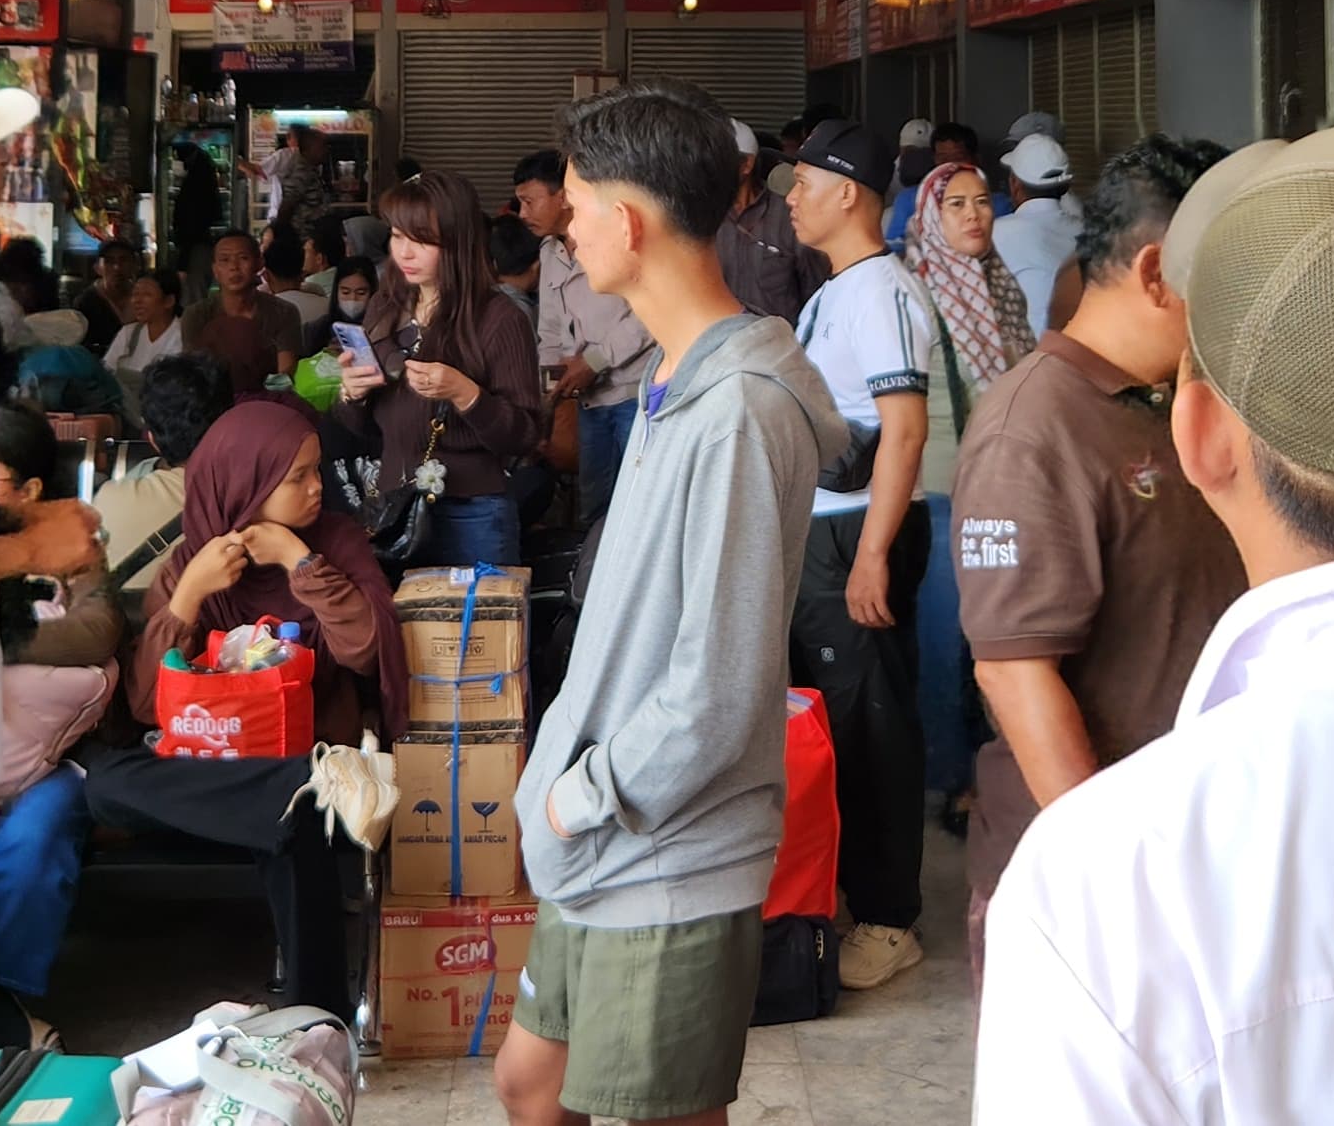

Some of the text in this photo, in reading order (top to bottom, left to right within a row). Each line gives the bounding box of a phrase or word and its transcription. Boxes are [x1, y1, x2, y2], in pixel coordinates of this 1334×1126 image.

[874, 374, 909, 390] CALVIN
[961, 517, 1017, 537] Always
[960, 535, 977, 551] be
[961, 536, 1019, 568] the first
[464, 834, 508, 843] AWAS PECAH
[384, 914, 419, 926] BARU
[491, 913, 522, 923] dus x
[441, 939, 490, 967] SGM
[406, 985, 462, 1027] No. 1
